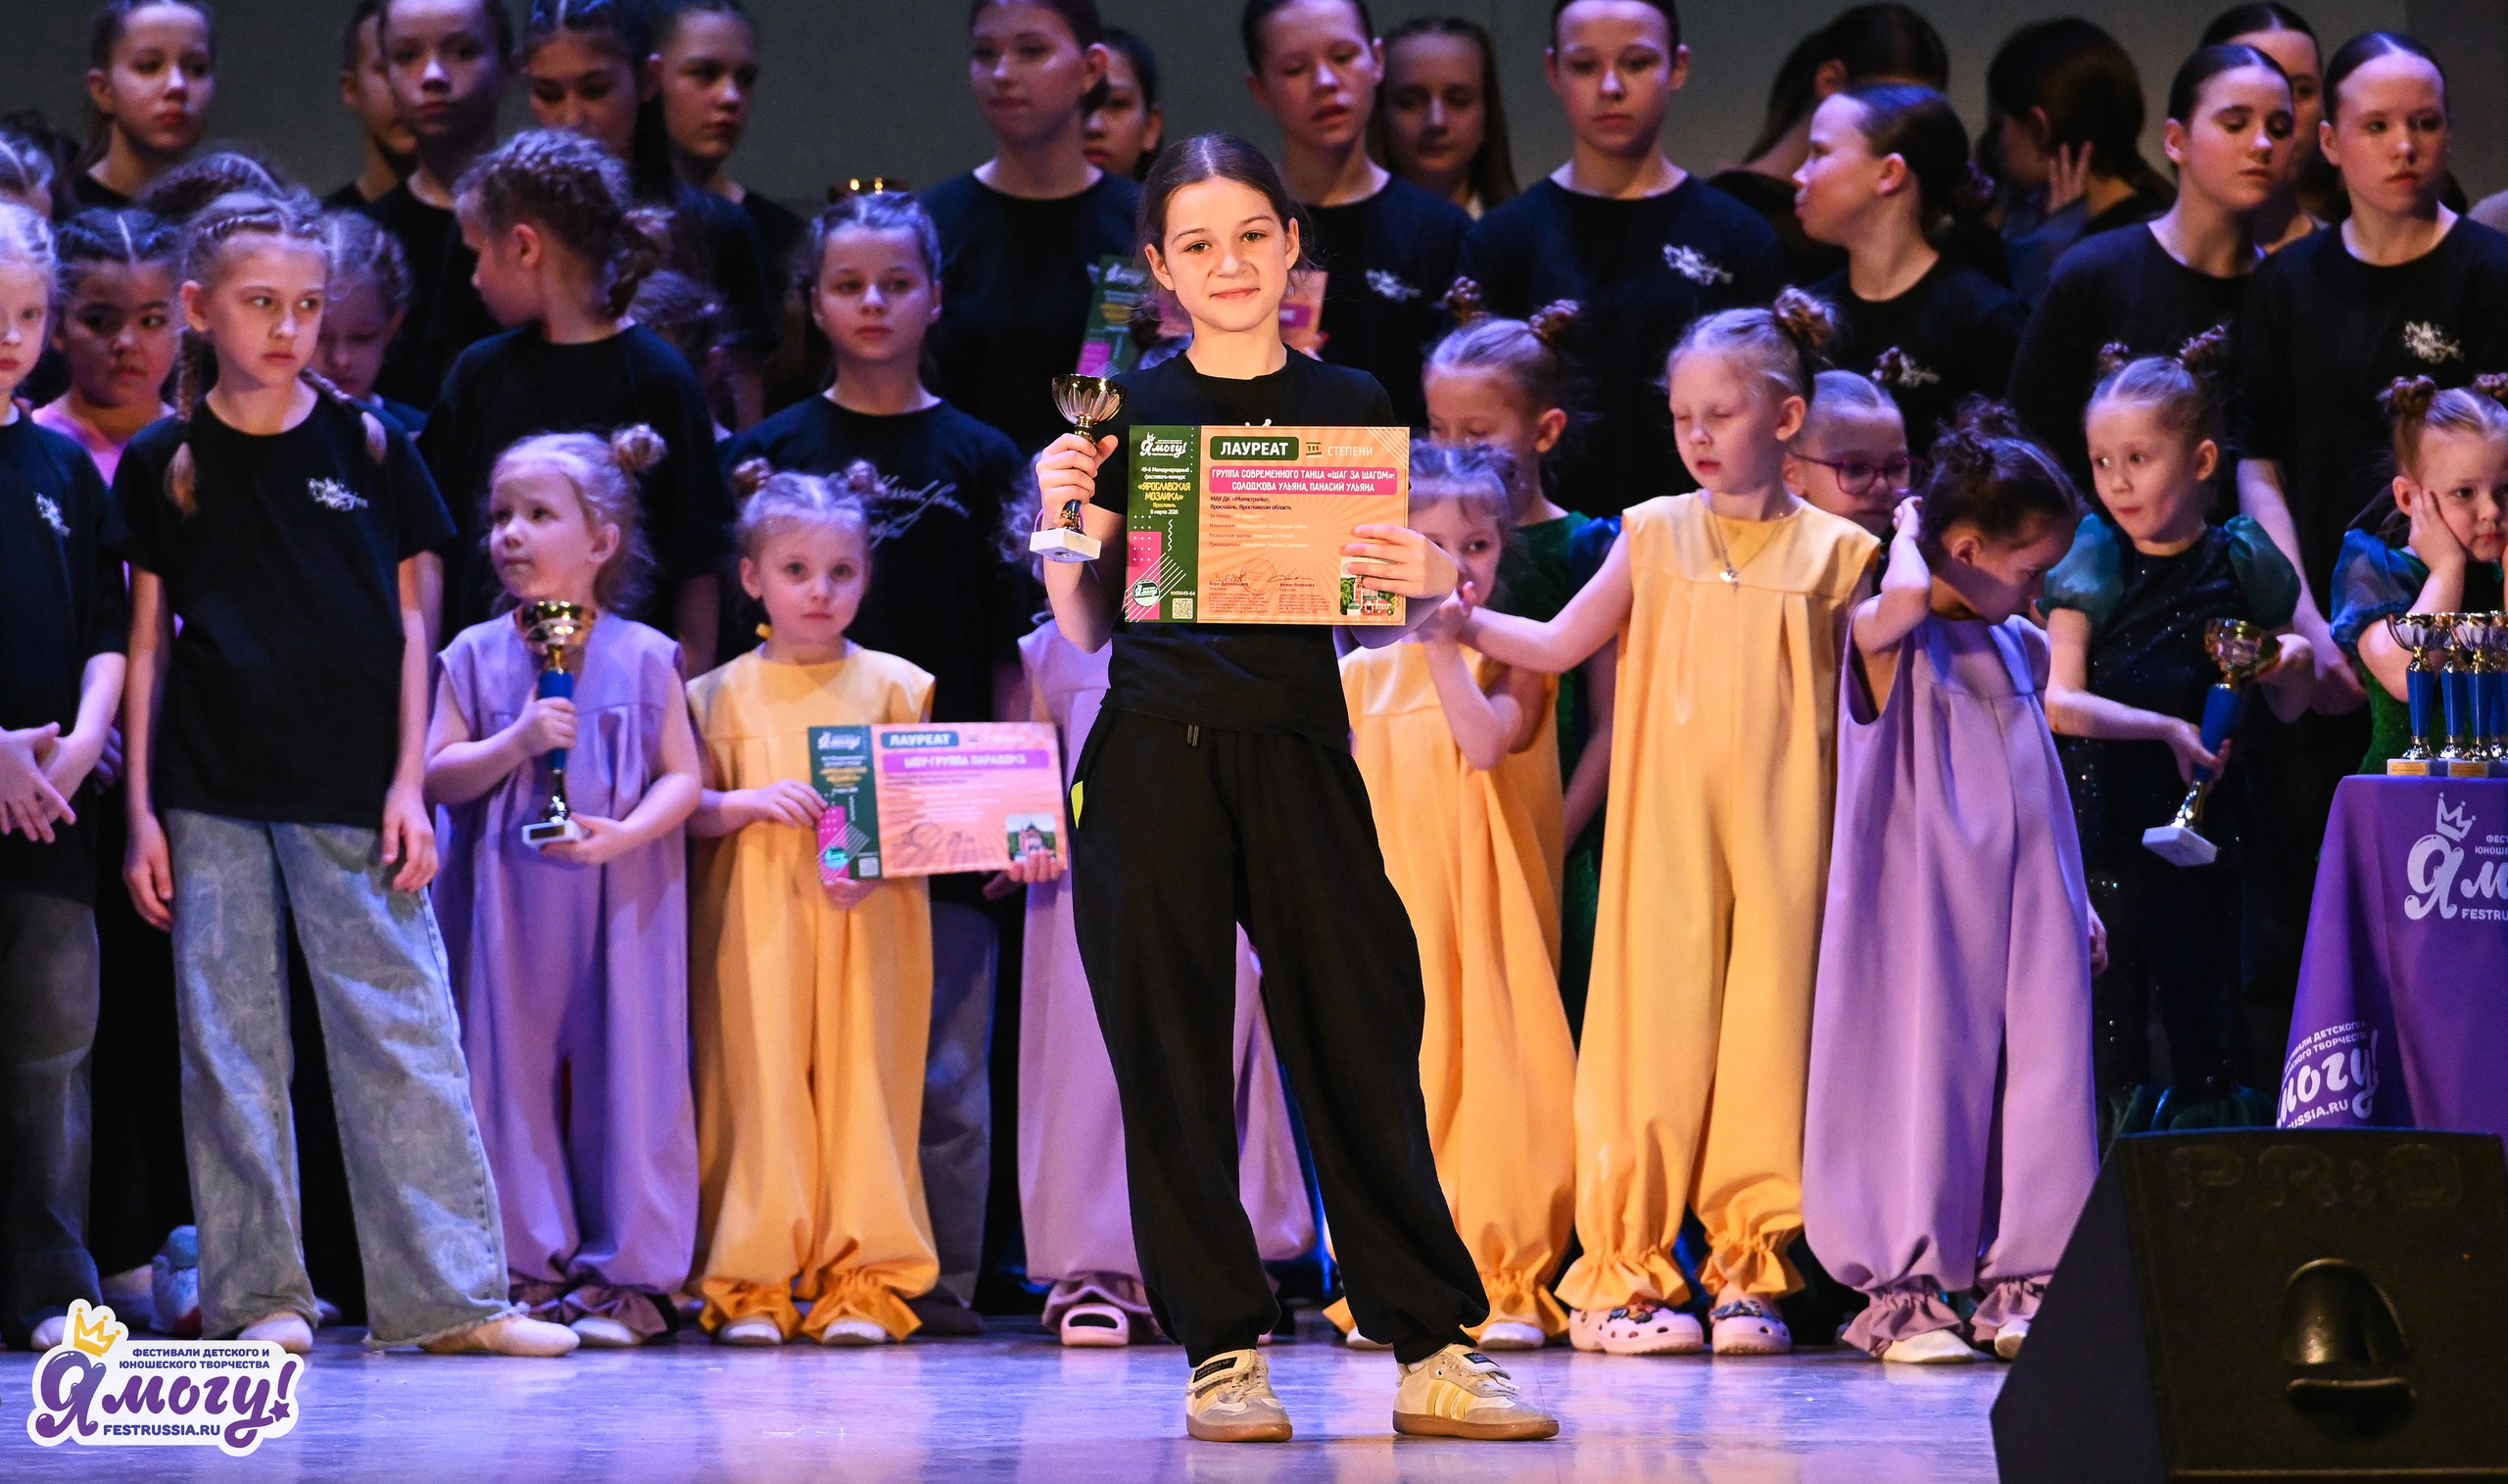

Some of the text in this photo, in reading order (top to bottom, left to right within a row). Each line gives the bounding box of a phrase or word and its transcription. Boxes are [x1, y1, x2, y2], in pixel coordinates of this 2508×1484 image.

[1140, 440, 1187, 458] Я могу!
[1221, 442, 1288, 455] ЛАУРЕАТ
[1327, 447, 1373, 456] СТЕПЕНИ
[1212, 469, 1239, 479] ГРУППА
[1241, 469, 1299, 479] СОВРЕМЕННОГО
[1301, 470, 1325, 480] ТАНЦА
[1326, 470, 1348, 479] «ШАГ
[1350, 470, 1359, 480] ЗА
[1137, 482, 1191, 491] «ЯРОСЛАВСКАЯ
[1232, 481, 1375, 492] СОЛОДКОВА УЛЬЯНА, ПАНАСИЙ УЛЬЯНА
[1144, 492, 1183, 501] МОЗАИКА»
[890, 734, 951, 746] ЛАУРЕАТ
[2461, 908, 2508, 921] FESTRU
